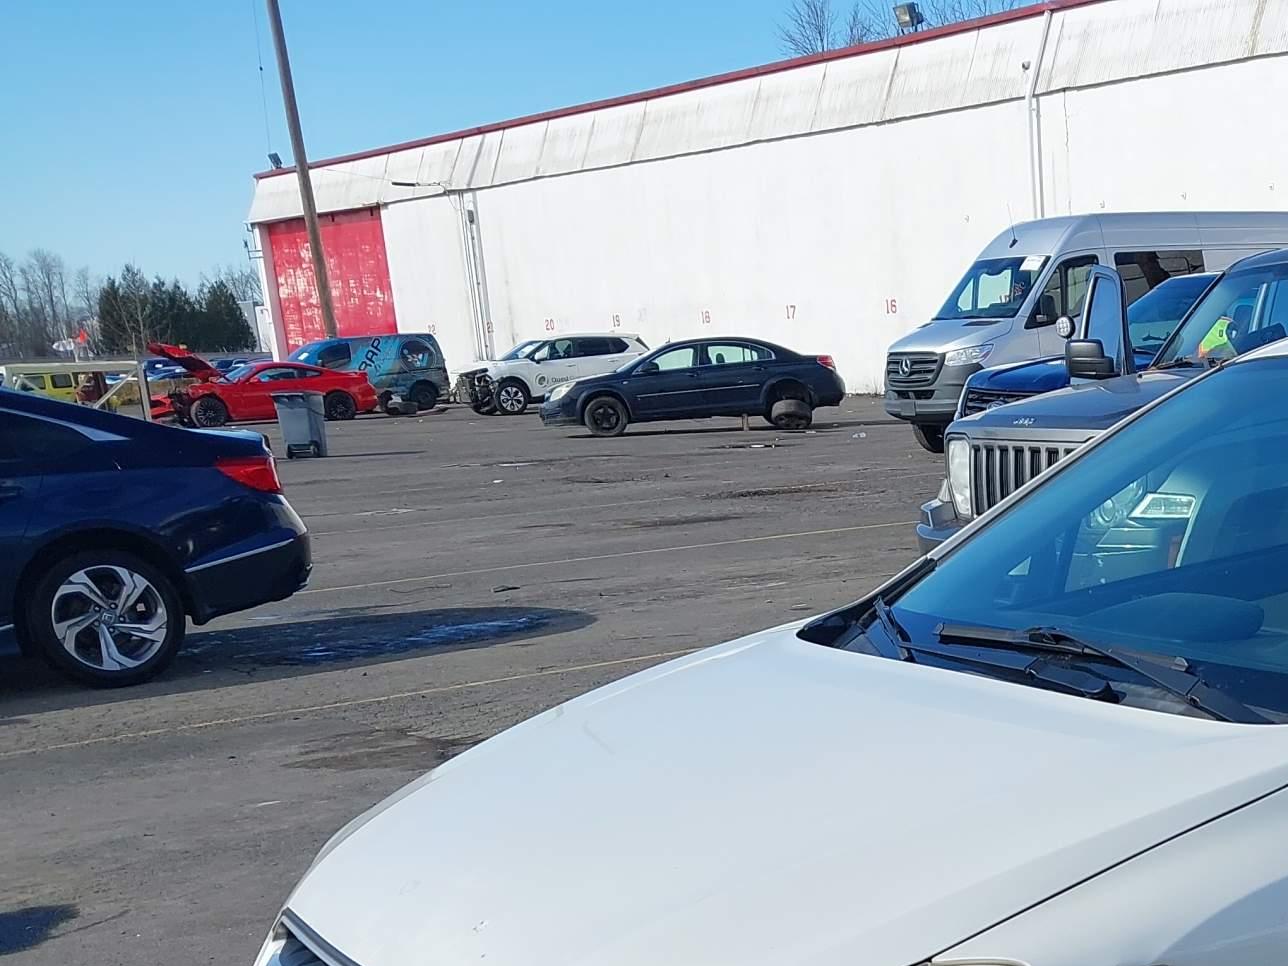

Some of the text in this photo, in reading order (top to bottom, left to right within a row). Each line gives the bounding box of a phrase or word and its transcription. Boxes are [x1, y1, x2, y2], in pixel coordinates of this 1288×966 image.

[785, 304, 796, 319] 17
[885, 298, 897, 314] 16
[544, 318, 555, 331] 20
[612, 314, 621, 328] 19
